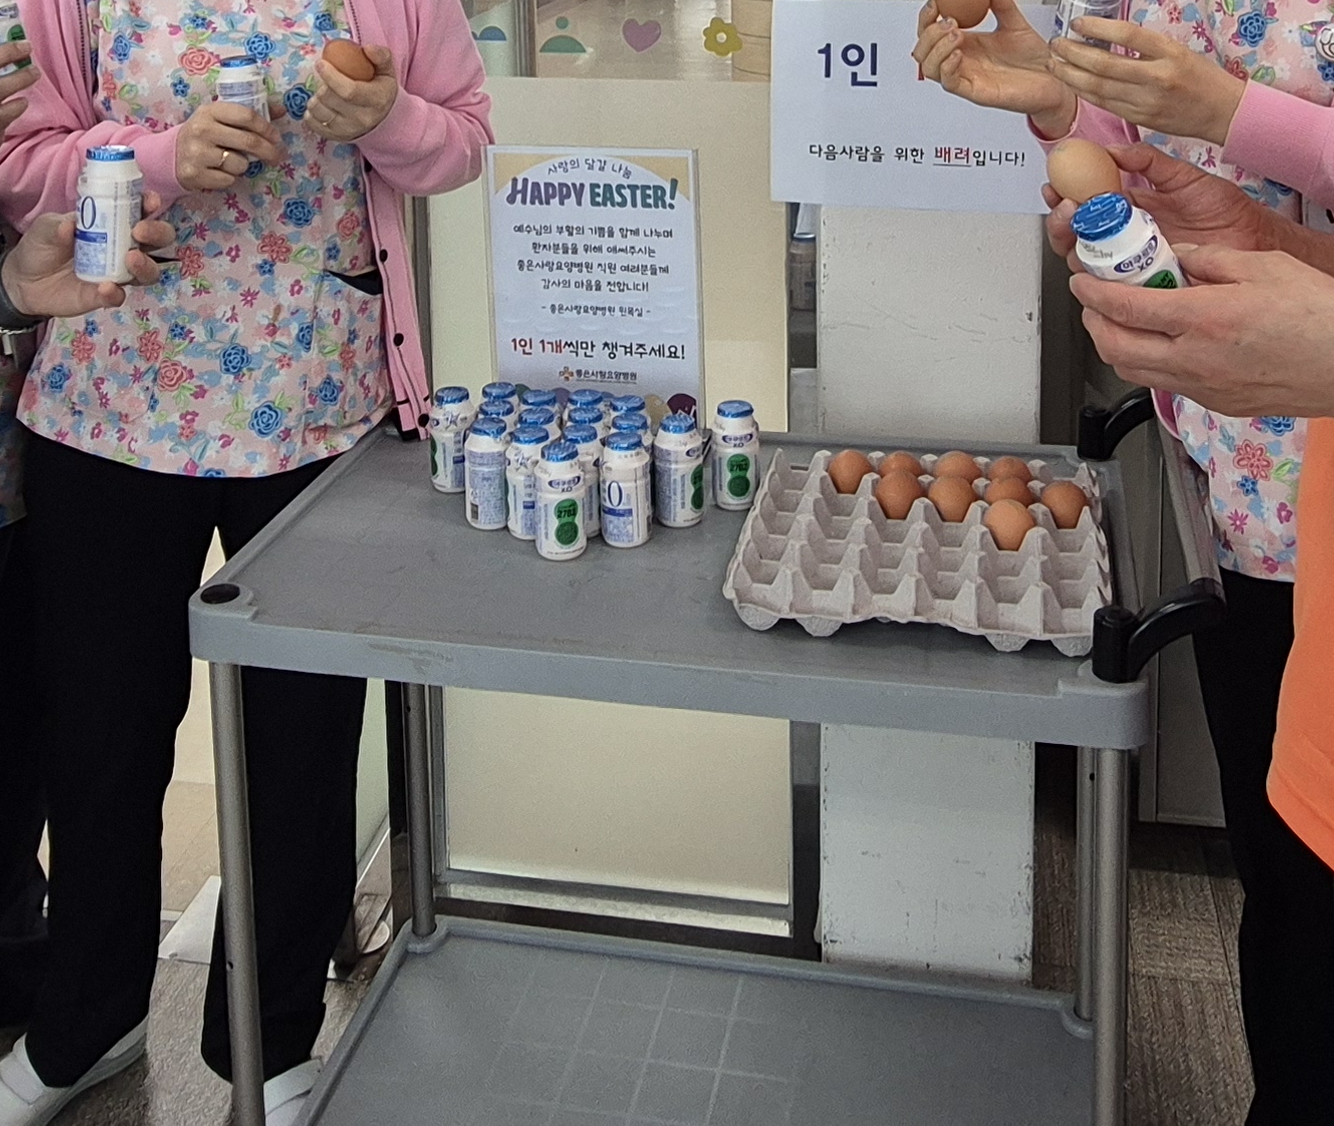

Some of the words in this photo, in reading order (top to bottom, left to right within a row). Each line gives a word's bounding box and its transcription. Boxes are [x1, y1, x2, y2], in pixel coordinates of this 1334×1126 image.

[816, 42, 878, 88] 1인
[810, 144, 885, 162] 다음사람을
[895, 148, 924, 164] 위한
[934, 145, 1025, 167] 배려입니다!
[547, 158, 580, 175] 사랑의
[585, 158, 607, 171] 달걀
[612, 164, 631, 179] 나눔
[506, 177, 585, 206] HAPPY
[589, 177, 679, 210] EASTER!
[513, 224, 552, 236] 예수님의
[557, 225, 584, 236] 부활의
[588, 226, 614, 238] 기쁨을
[619, 227, 640, 238] 함께
[644, 228, 672, 238] 나누며
[532, 242, 578, 255] 환자분들을
[583, 244, 603, 254] 위해
[607, 245, 656, 258] 애써주시는
[518, 260, 593, 273] 좋은사랑요양병원
[597, 263, 616, 274] 직원
[542, 279, 570, 289] 감사의
[574, 280, 601, 291] 마음을
[607, 281, 648, 292] 전합니다!
[550, 304, 615, 316] 좋은사랑요양병원
[619, 306, 643, 317] 원목실
[512, 338, 532, 355] 1인
[539, 339, 596, 358] 1개씩만
[602, 342, 685, 359] 챙겨주세요!
